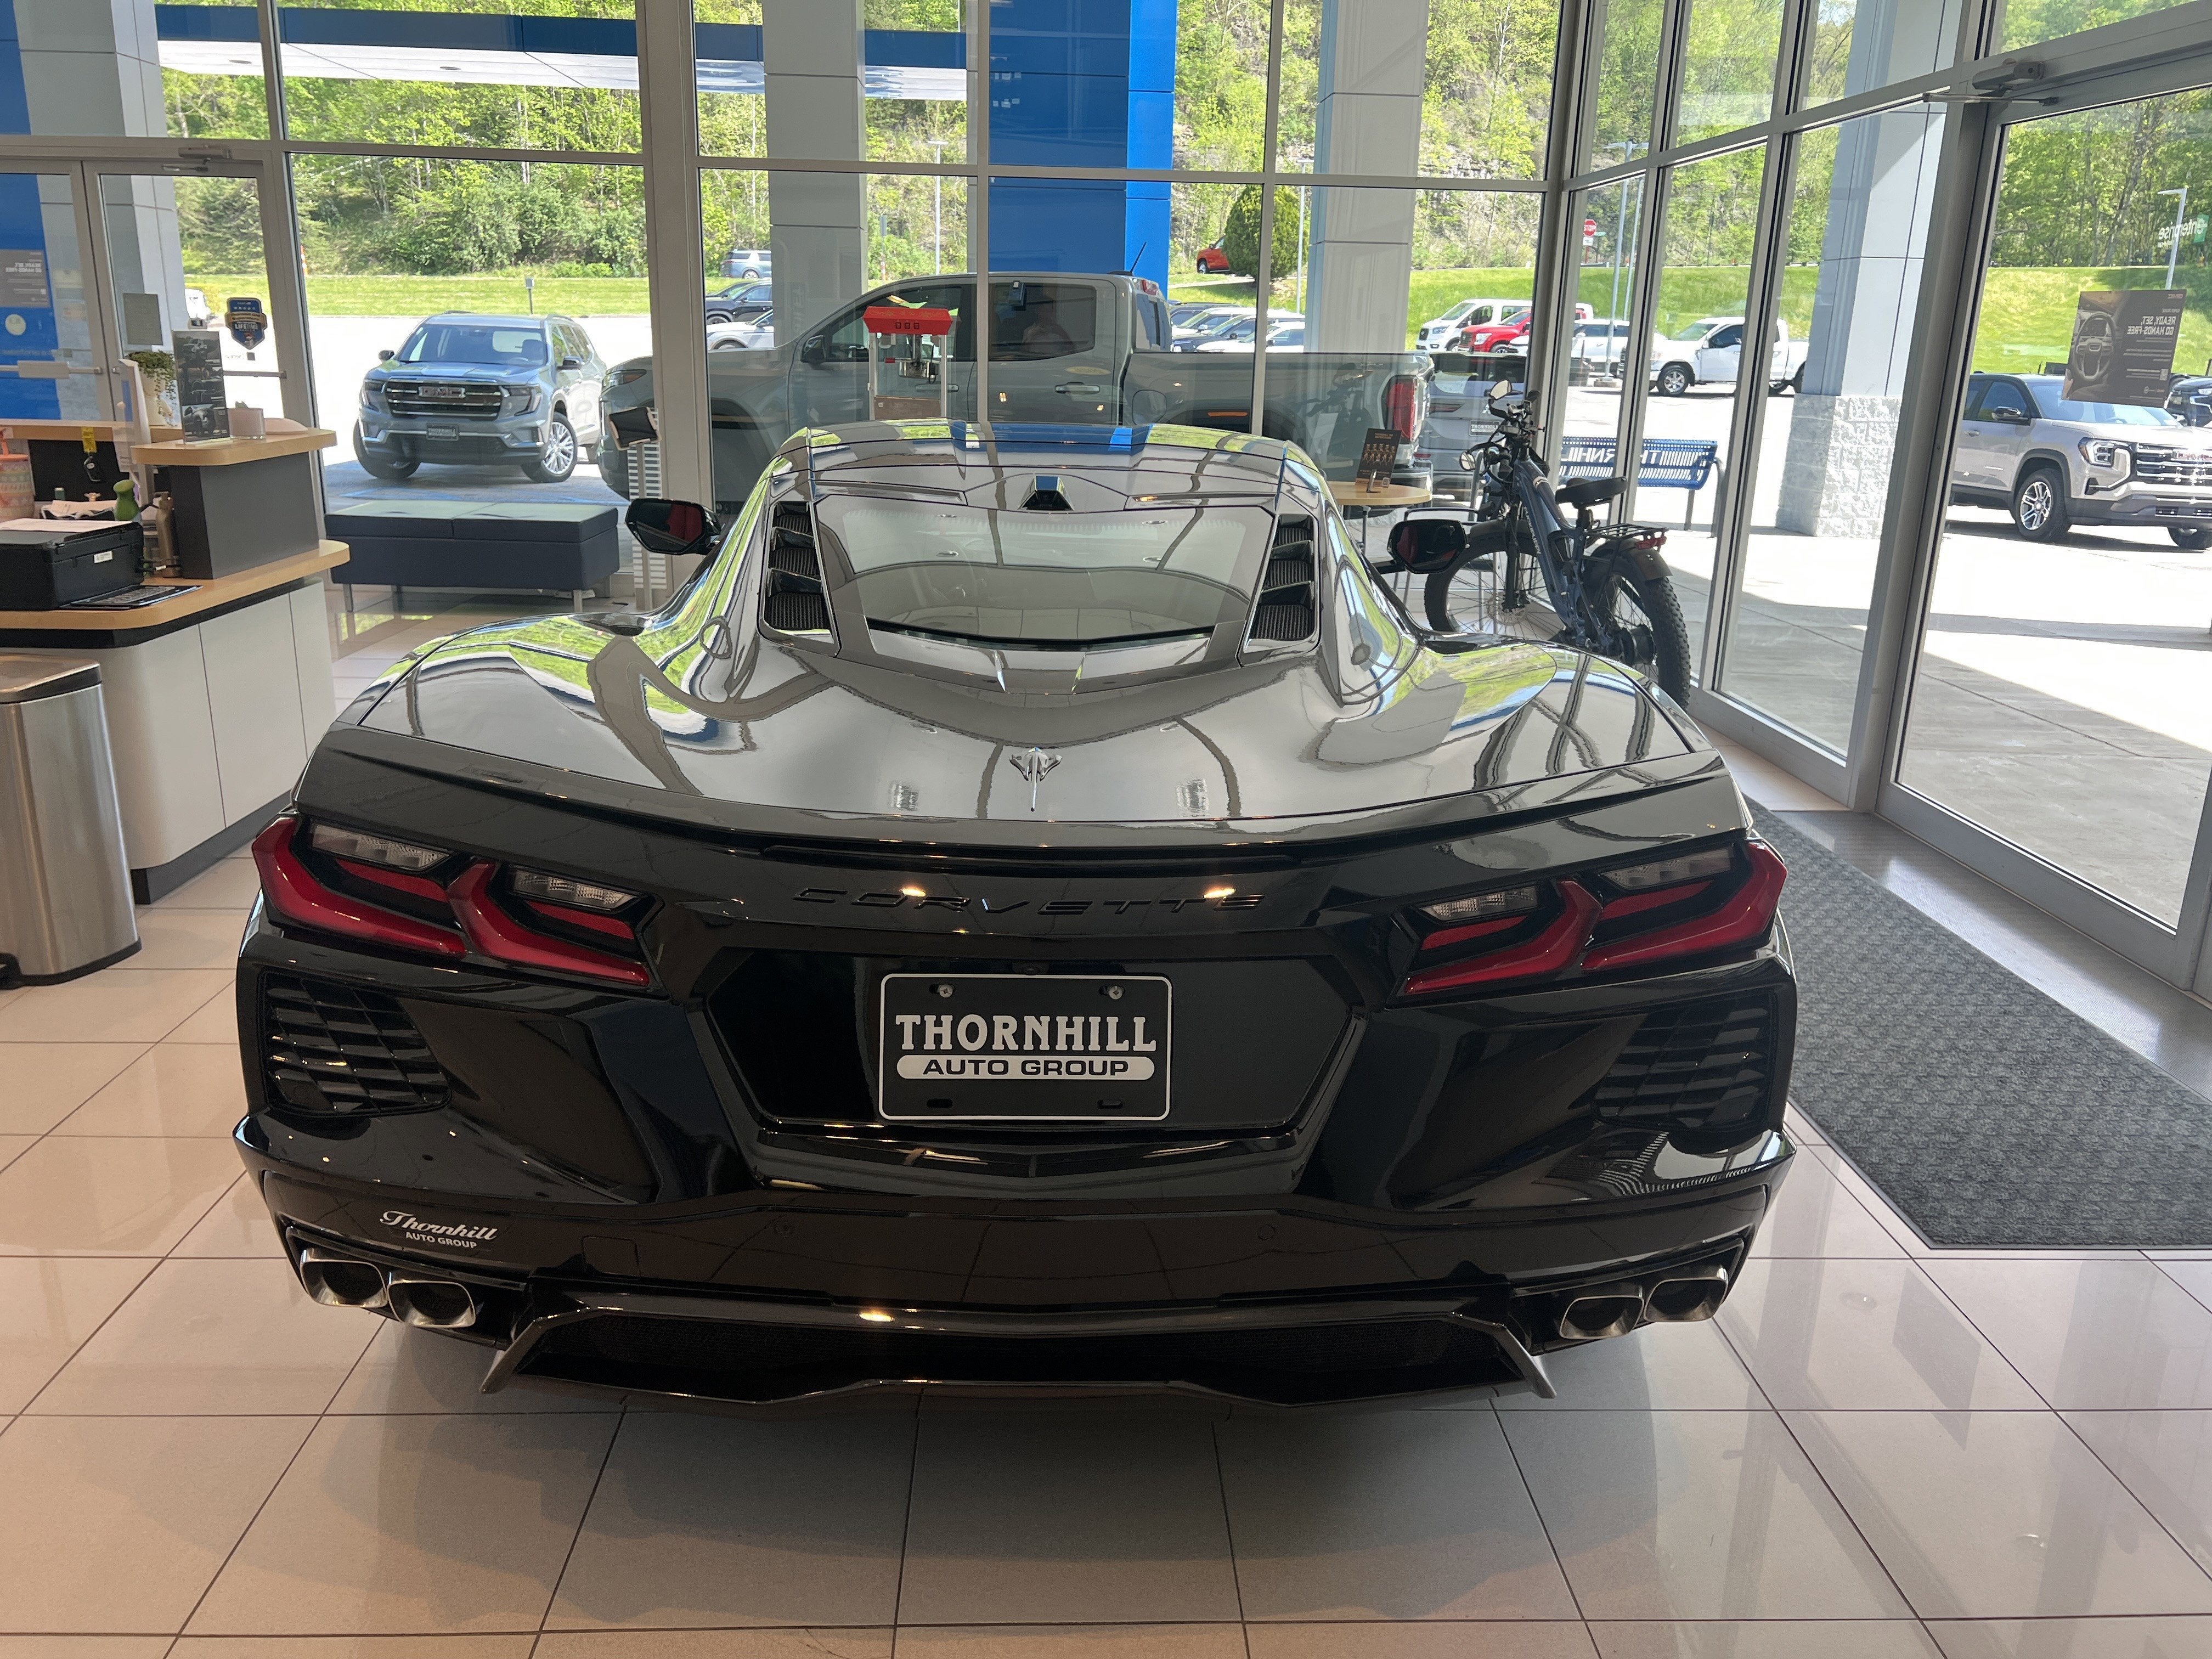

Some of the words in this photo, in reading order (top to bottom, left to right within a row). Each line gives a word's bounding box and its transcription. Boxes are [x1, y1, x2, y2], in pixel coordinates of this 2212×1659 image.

[422, 386, 461, 396] GMC
[792, 888, 1265, 915] CORVETTE
[895, 1014, 1156, 1052] THORNHILL
[923, 1059, 1010, 1076] AUTO
[1020, 1059, 1129, 1076] GROUP
[379, 1210, 498, 1240] Thornhill
[405, 1232, 436, 1243] AUTO
[437, 1237, 477, 1249] GROUP
